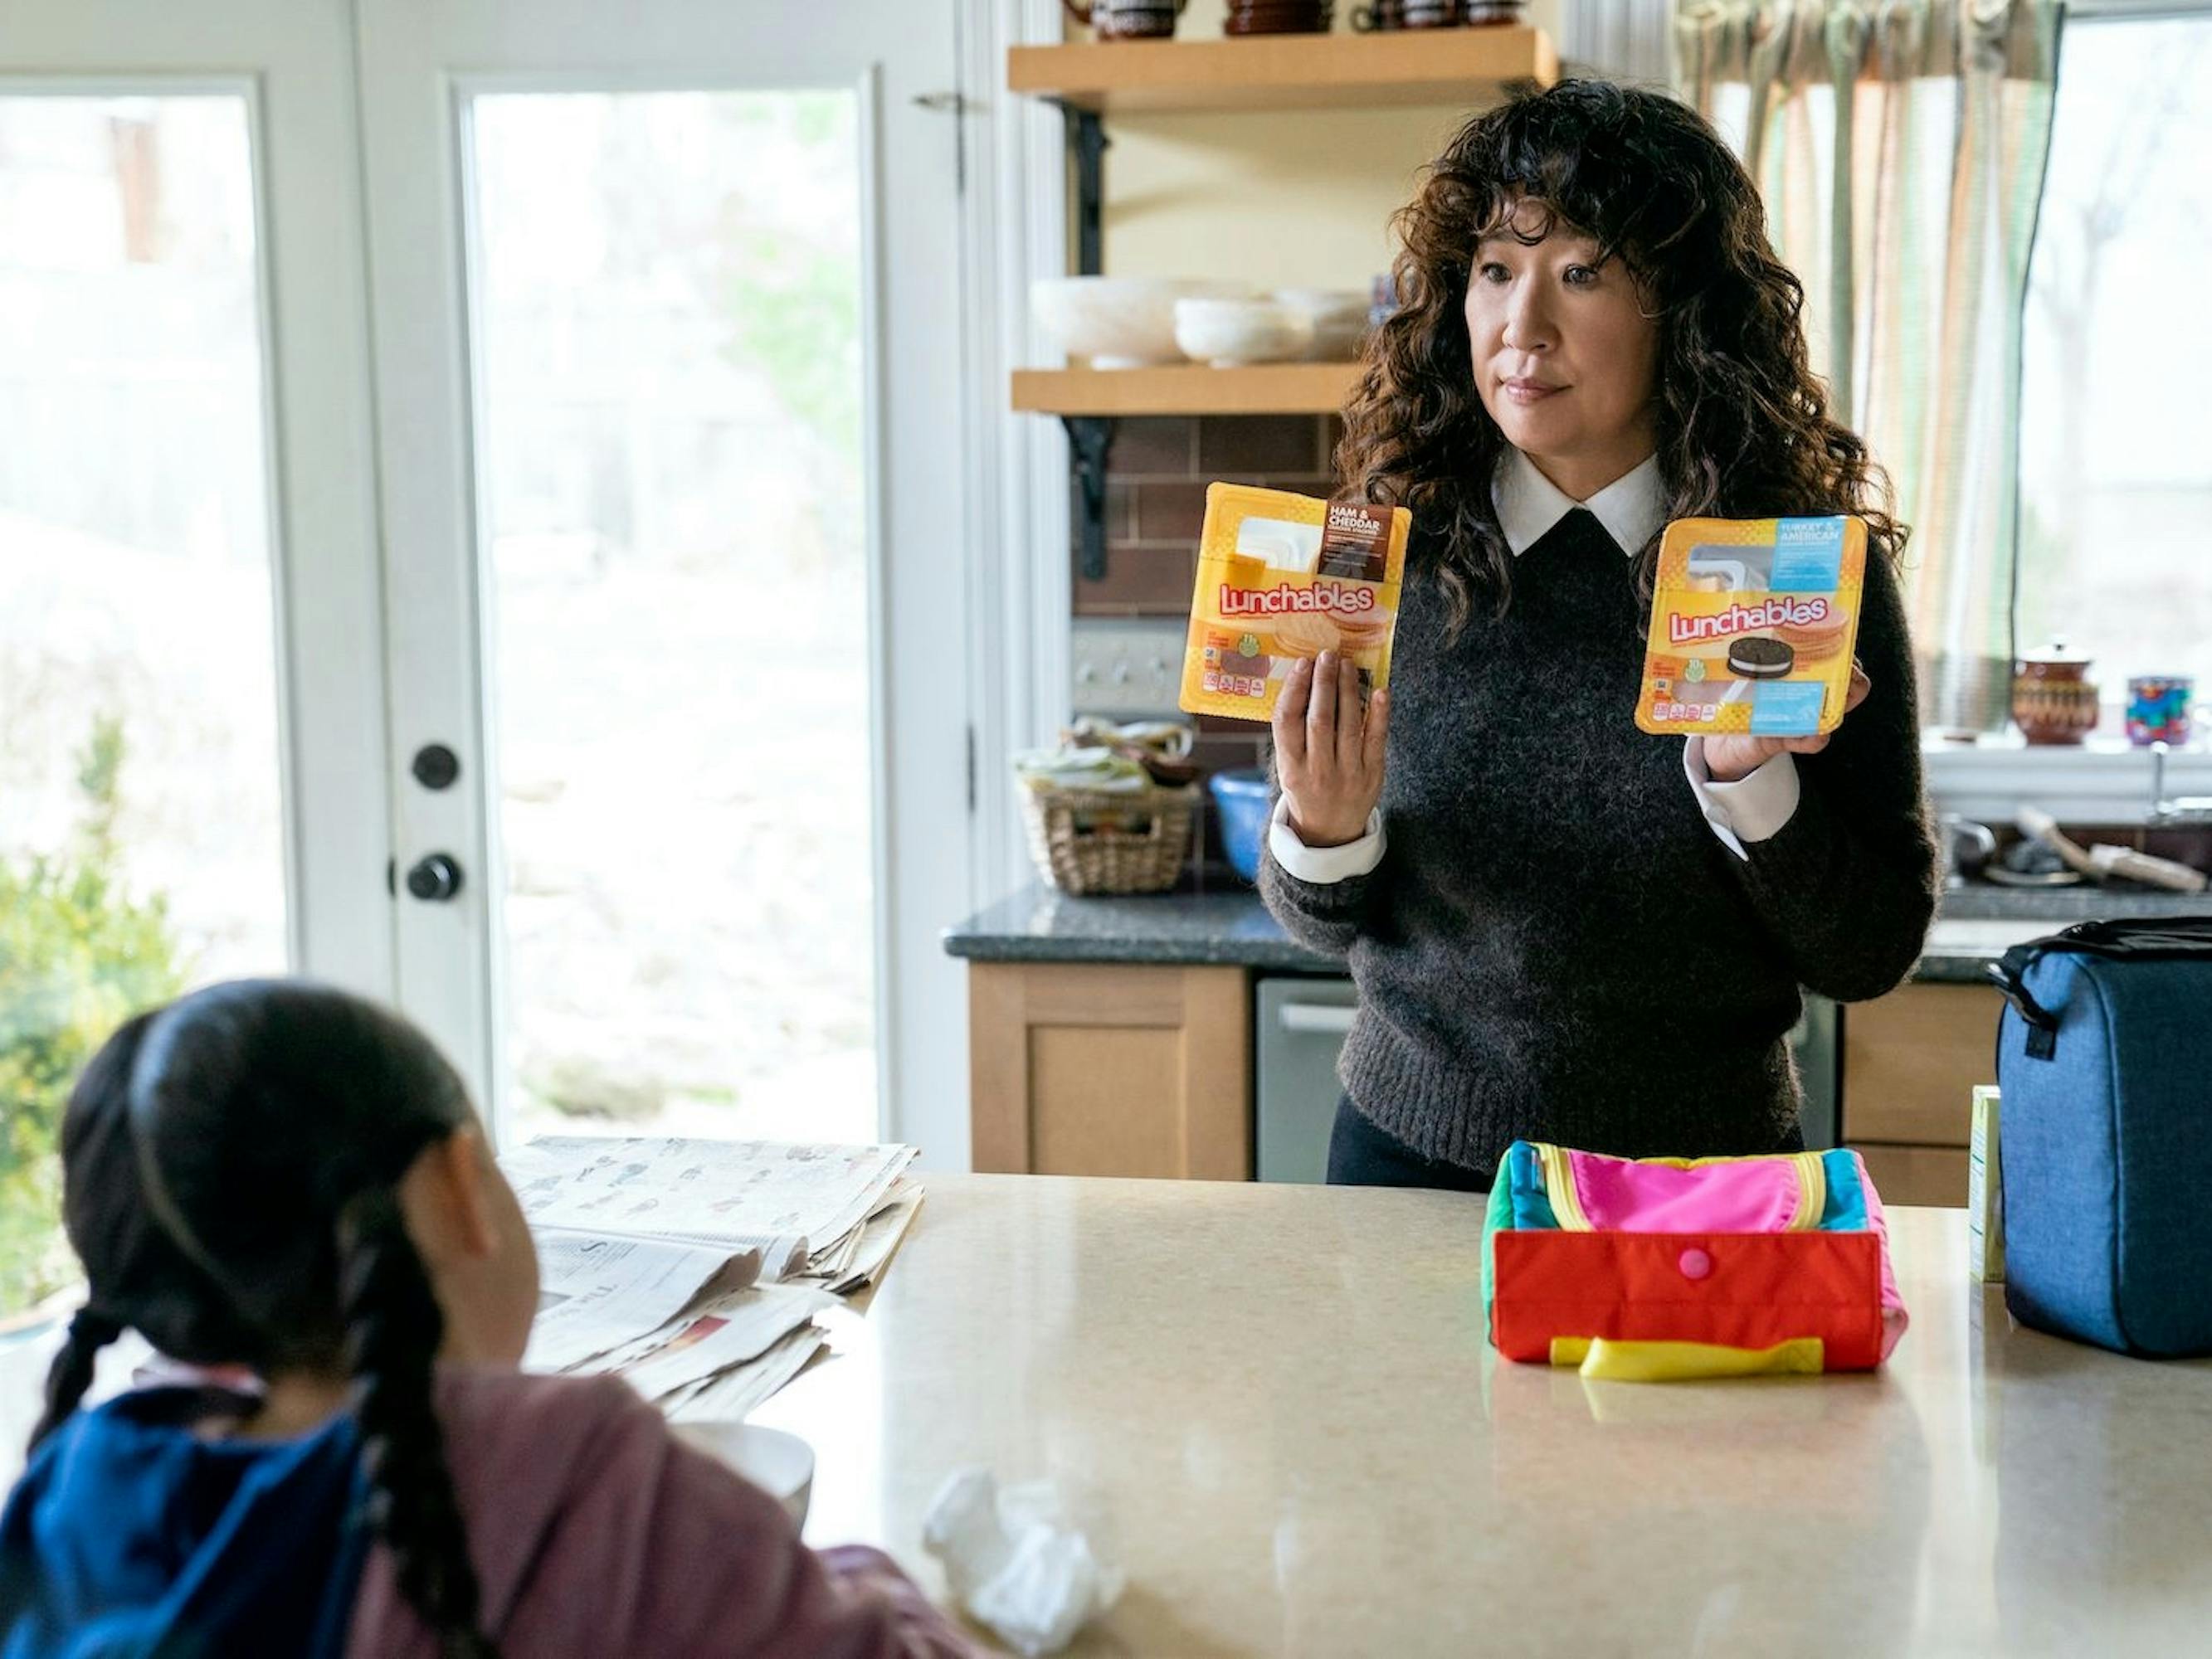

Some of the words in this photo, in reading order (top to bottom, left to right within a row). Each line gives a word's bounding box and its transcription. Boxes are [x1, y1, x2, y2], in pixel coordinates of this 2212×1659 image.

[1330, 506, 1357, 518] HAM
[1359, 509, 1368, 520] &
[1328, 515, 1381, 532] CHEDDAR
[1781, 531, 1839, 540] AMERICAN
[1220, 582, 1374, 615] Lunchables
[1669, 596, 1828, 642] Lunchables
